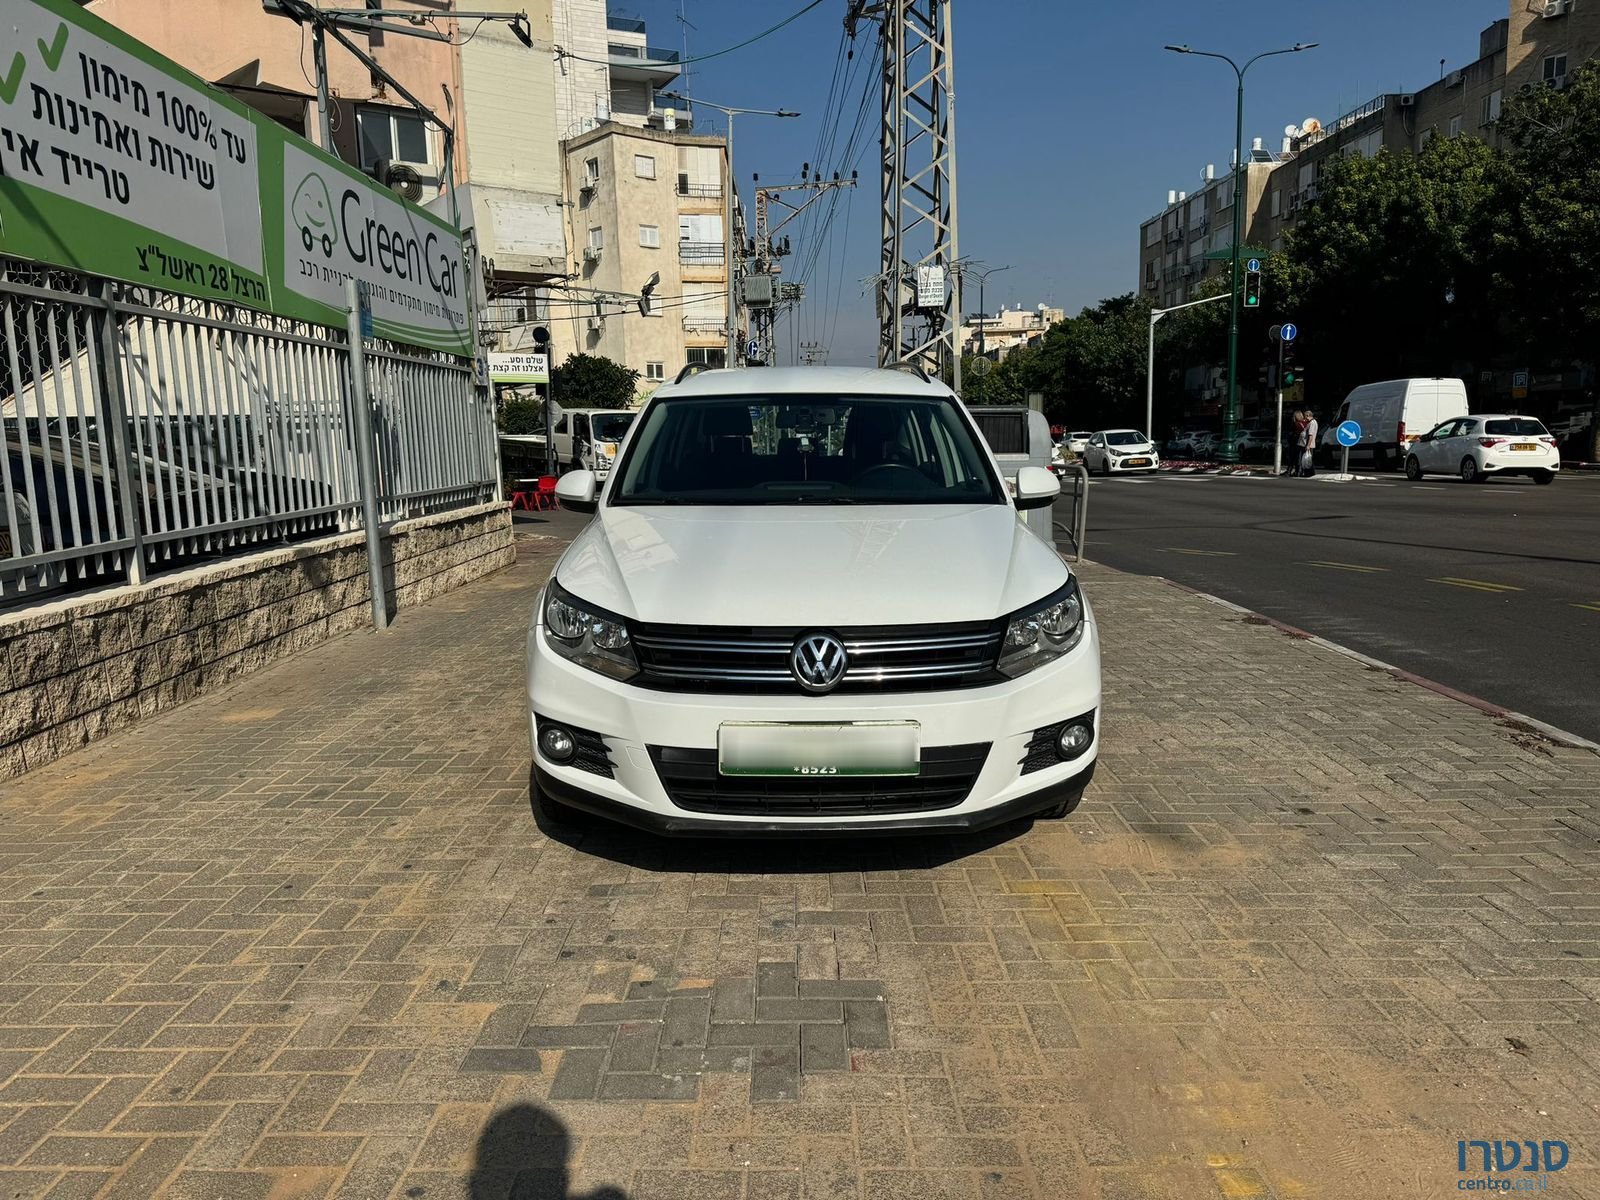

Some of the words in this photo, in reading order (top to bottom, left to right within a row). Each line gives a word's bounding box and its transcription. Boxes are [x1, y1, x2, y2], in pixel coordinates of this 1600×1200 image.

[79, 52, 150, 118] מימון
[30, 82, 142, 161] ואמינות
[157, 91, 217, 150] 100%
[221, 127, 246, 164] עד
[51, 145, 130, 205] טרייד
[148, 135, 215, 190] שירות
[341, 189, 422, 286] Green
[425, 232, 458, 299] Car
[210, 263, 229, 292] 28
[231, 267, 266, 301] הרצל
[300, 259, 319, 279] רכב
[390, 289, 422, 312] מתקדמים
[424, 301, 440, 317] מימון
[493, 364, 510, 373] קצת
[511, 364, 521, 372] זה
[522, 364, 544, 372] אצלנו
[526, 356, 543, 364] שלם
